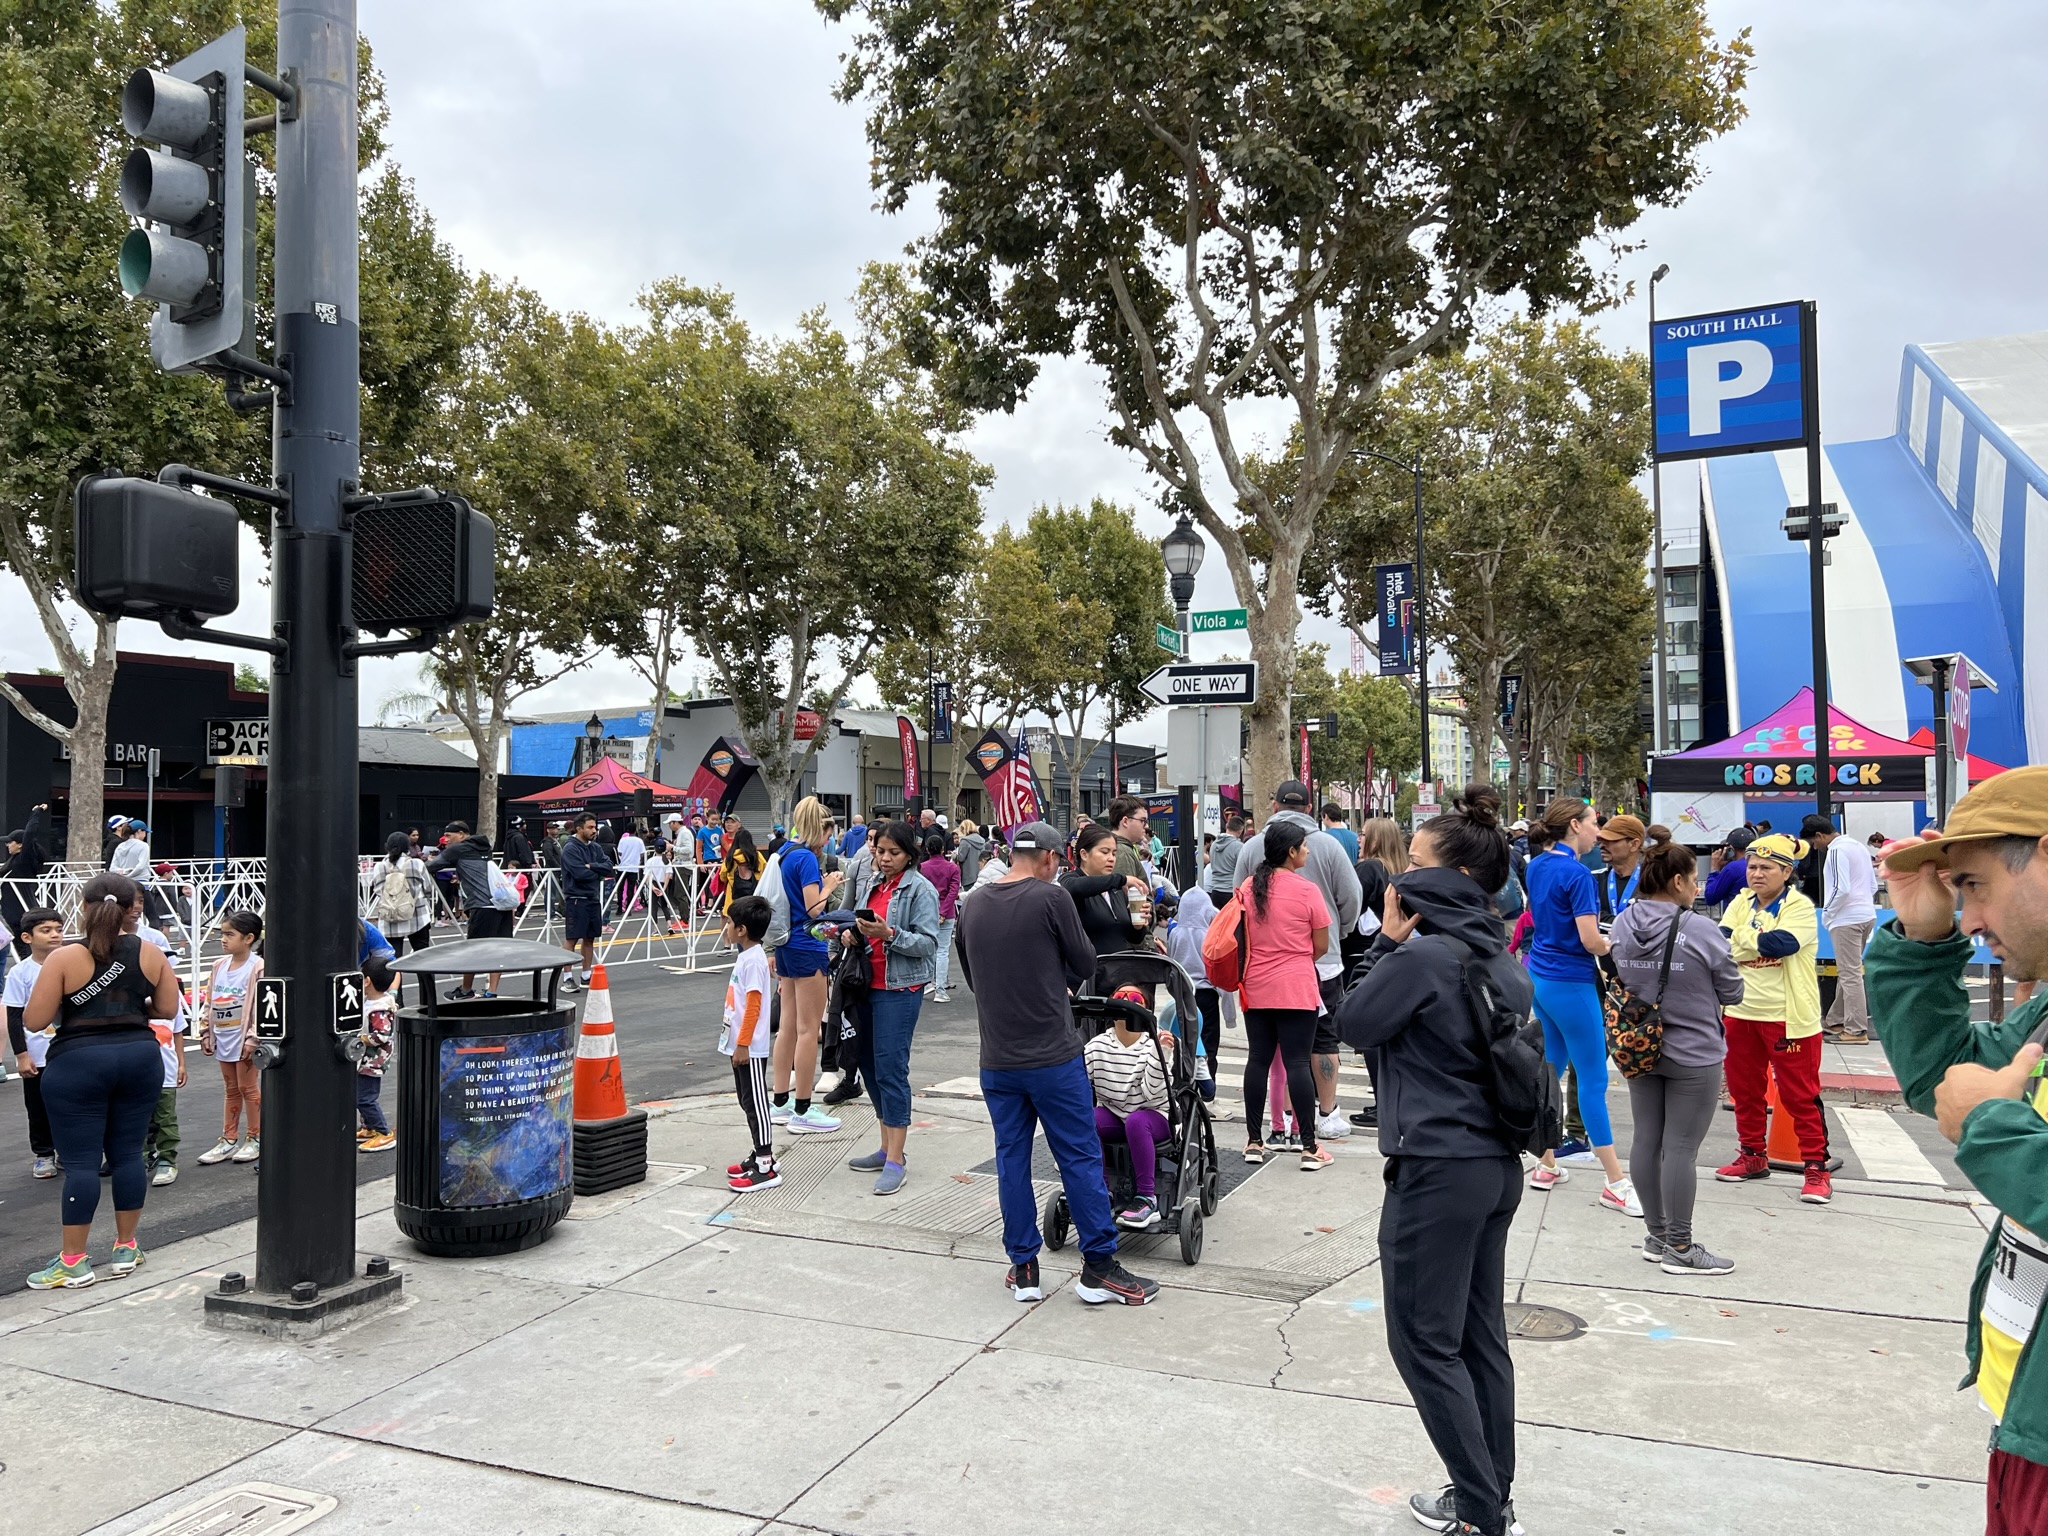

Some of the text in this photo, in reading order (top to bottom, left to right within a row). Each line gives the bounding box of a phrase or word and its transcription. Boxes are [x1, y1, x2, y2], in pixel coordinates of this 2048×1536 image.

[1667, 313, 1782, 339] SOUTH HALL
[1687, 340, 1774, 437] P
[1394, 572, 1406, 596] intel
[1386, 573, 1396, 628] innovation
[1193, 615, 1227, 629] Viola
[1160, 630, 1175, 649] Market
[1172, 676, 1239, 693] ONE WAY
[1953, 686, 1969, 730] STOP
[115, 744, 147, 762] BAR
[1149, 798, 1173, 807] Budget
[1630, 960, 1655, 969] PRESENT
[1658, 962, 1685, 971] FURE
[71, 961, 126, 1005] DO IT NOW
[478, 1061, 499, 1069] LOOK!
[502, 1058, 530, 1067] THERE'S
[532, 1054, 550, 1064] TRASH
[552, 1051, 558, 1060] ON
[506, 1072, 515, 1080] UP
[518, 1069, 539, 1078] WOULD
[541, 1067, 548, 1075] BE
[465, 1088, 479, 1096] BUT
[482, 1086, 507, 1095] THINK,
[509, 1082, 541, 1092] WOULDN'T
[477, 1100, 497, 1108] HAVE
[508, 1095, 545, 1107] BEAUTIFUL,
[546, 1090, 560, 1100] CLEAN
